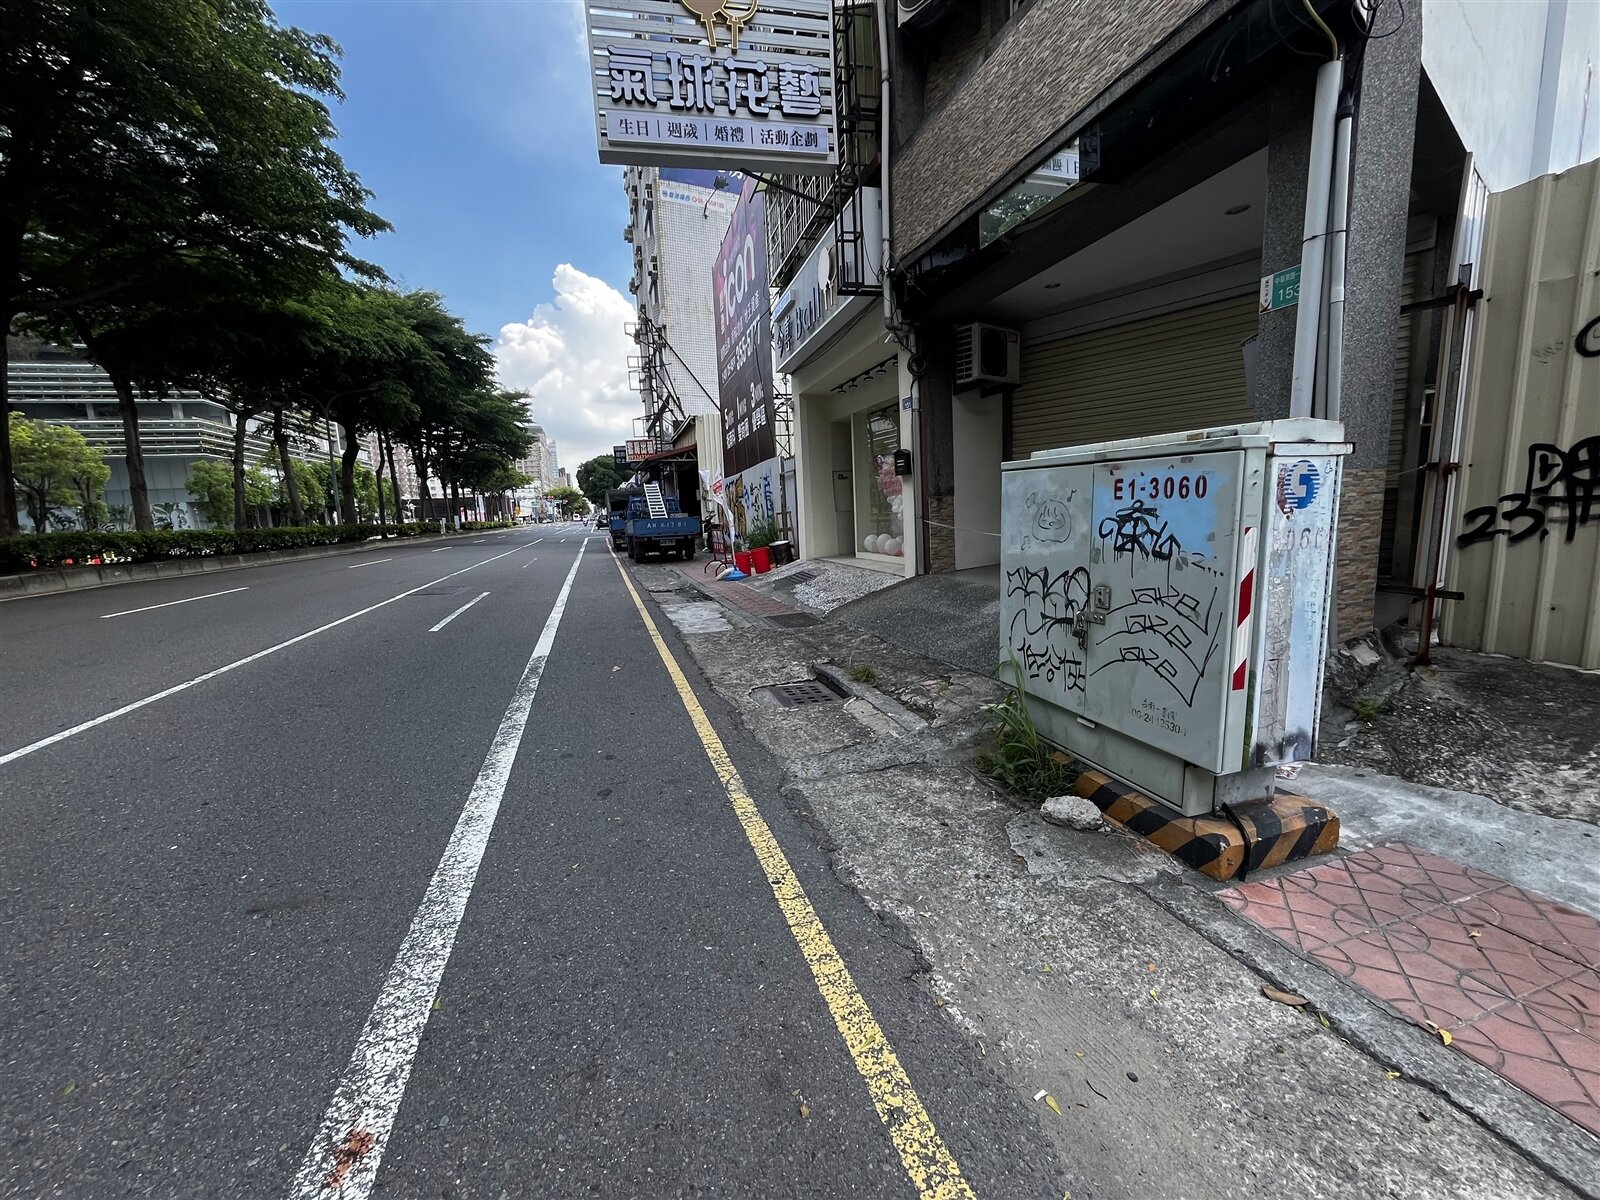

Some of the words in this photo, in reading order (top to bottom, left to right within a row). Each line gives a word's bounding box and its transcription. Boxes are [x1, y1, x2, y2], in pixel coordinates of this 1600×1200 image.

[607, 45, 822, 116] 氣球花藝
[619, 118, 649, 136] 生日
[667, 121, 699, 140] 週歲
[714, 125, 745, 143] 婚禮
[760, 128, 819, 148] 活動企劃
[721, 233, 757, 326] icon
[1278, 283, 1301, 301] 153
[1113, 475, 1208, 501] E1-3060
